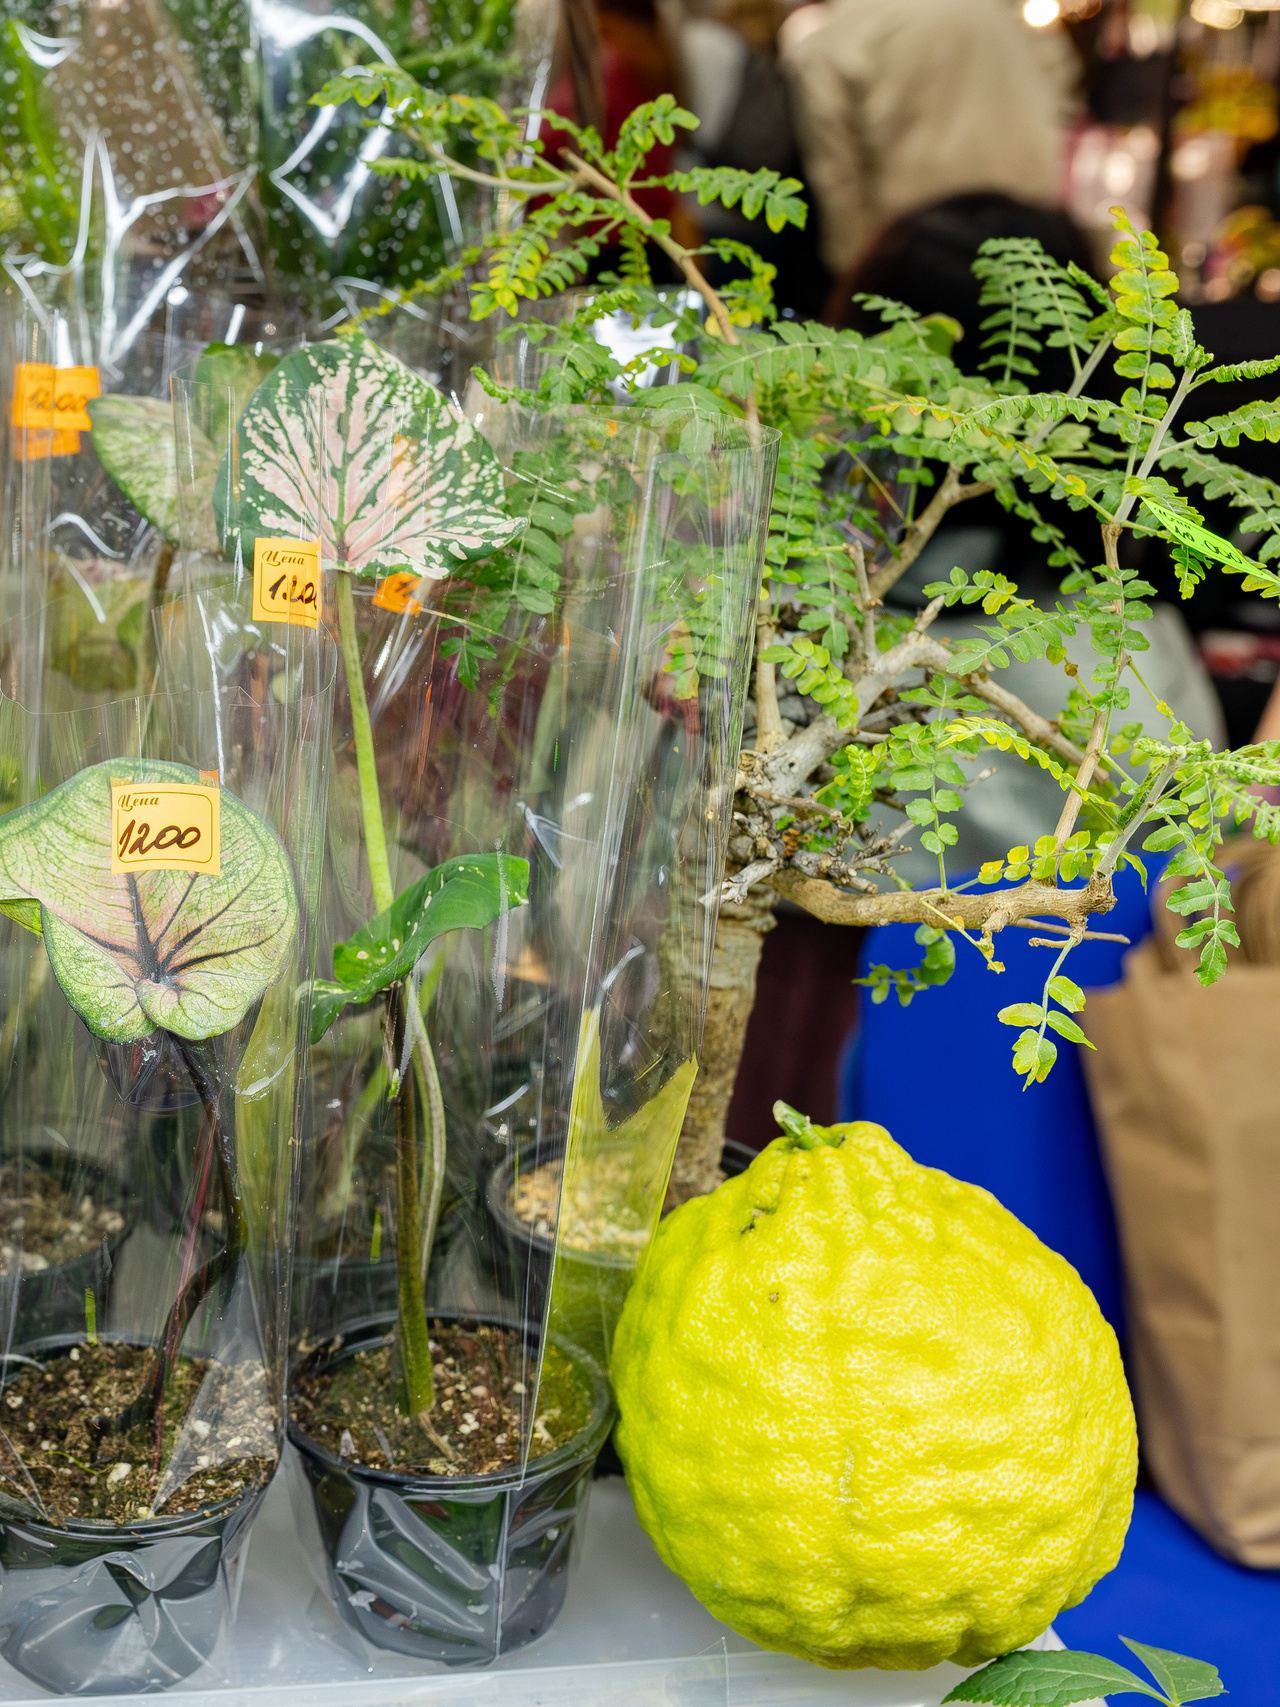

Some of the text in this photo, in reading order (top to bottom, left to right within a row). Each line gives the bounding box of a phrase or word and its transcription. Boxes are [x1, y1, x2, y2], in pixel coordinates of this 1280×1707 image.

[262, 550, 305, 567] Цена
[118, 794, 161, 812] Цена
[119, 818, 201, 858] 1200
